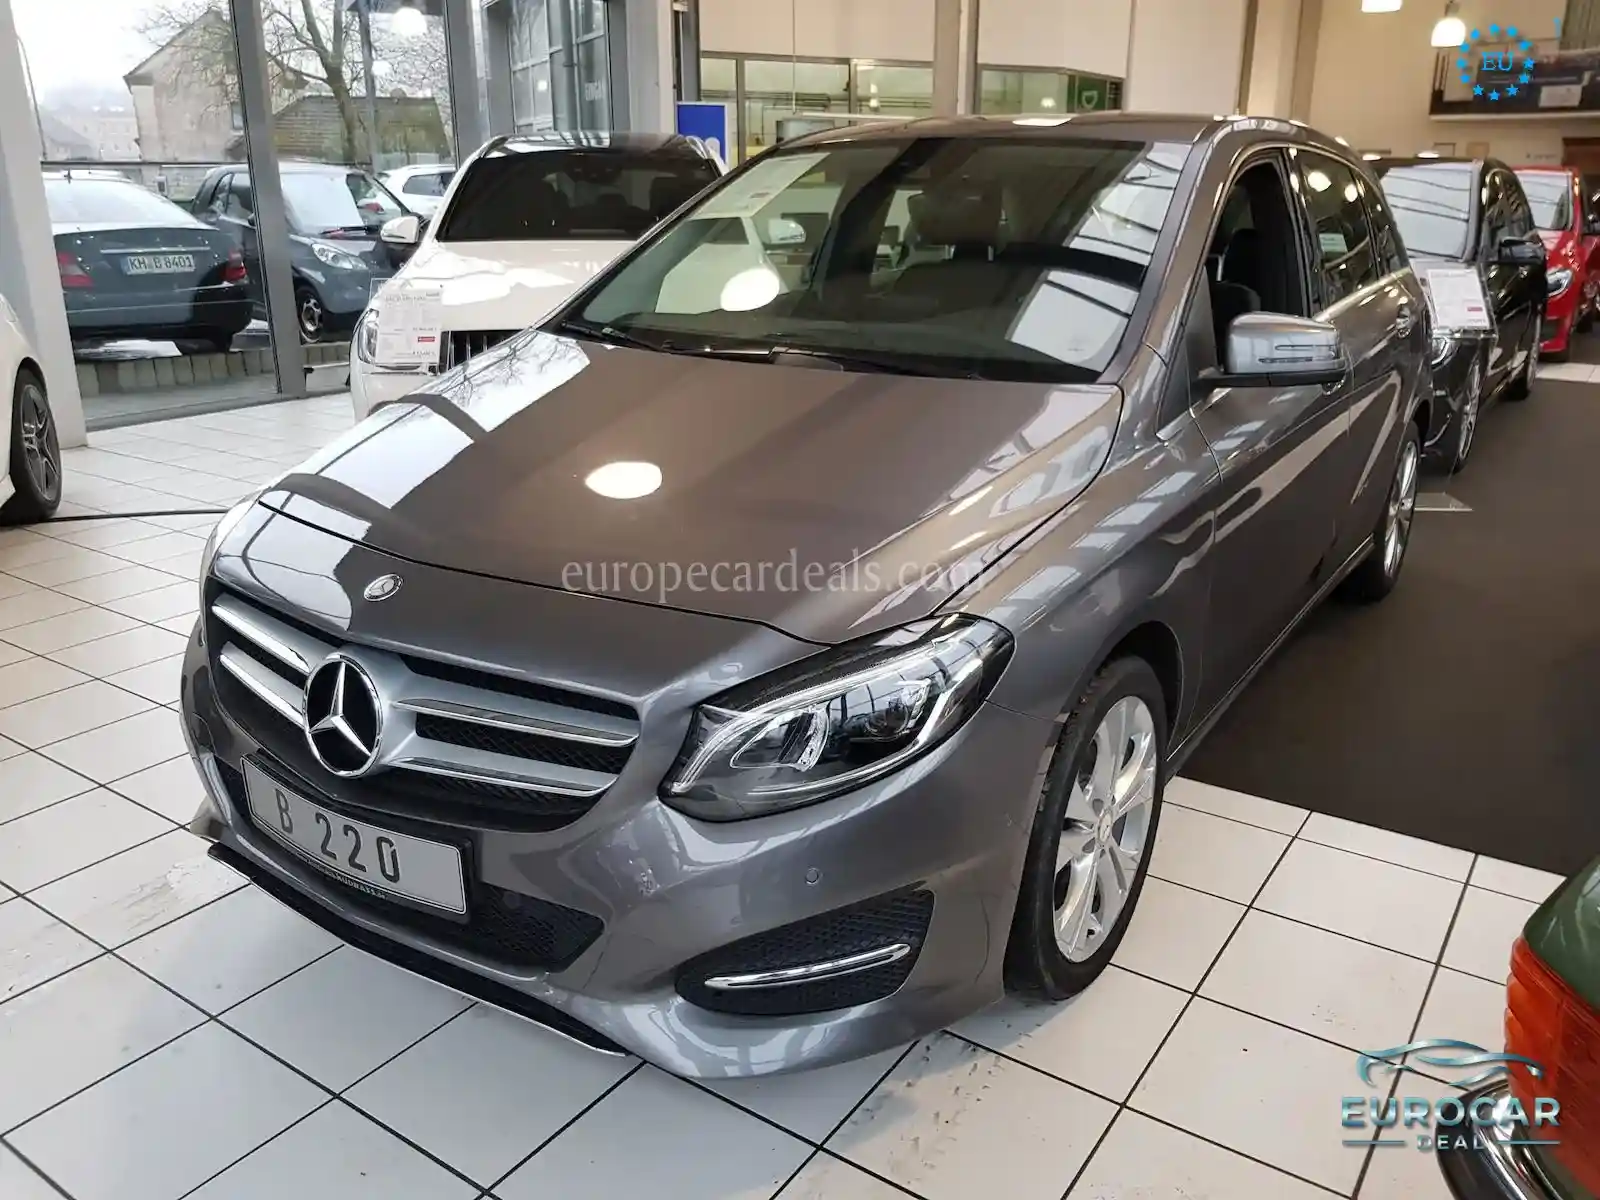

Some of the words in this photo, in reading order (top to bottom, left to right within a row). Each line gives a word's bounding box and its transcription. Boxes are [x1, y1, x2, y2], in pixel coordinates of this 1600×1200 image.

[129, 257, 148, 270] KH
[165, 255, 193, 269] 8401
[274, 788, 294, 835] B
[315, 812, 400, 884] 220
